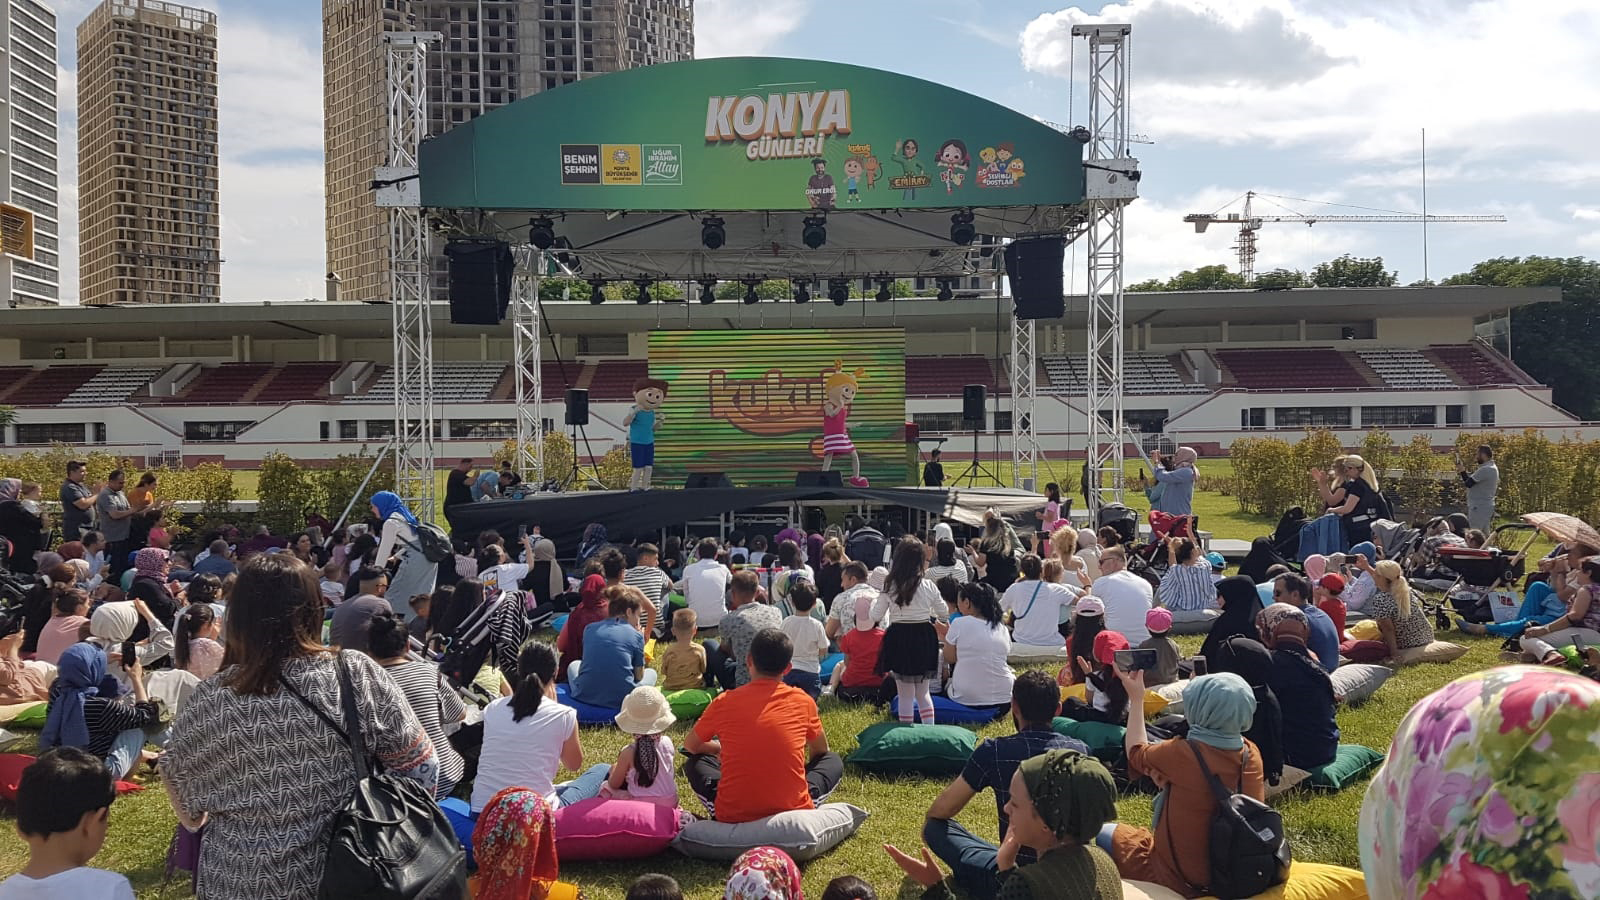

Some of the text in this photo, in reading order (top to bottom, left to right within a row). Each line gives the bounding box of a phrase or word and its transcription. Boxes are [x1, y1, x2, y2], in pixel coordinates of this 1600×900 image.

[704, 89, 851, 141] KONYA
[746, 131, 825, 161] GÜNLERİ
[563, 154, 598, 165] BENİM
[564, 165, 598, 176] ŞEHRİM
[646, 161, 680, 179] Altay
